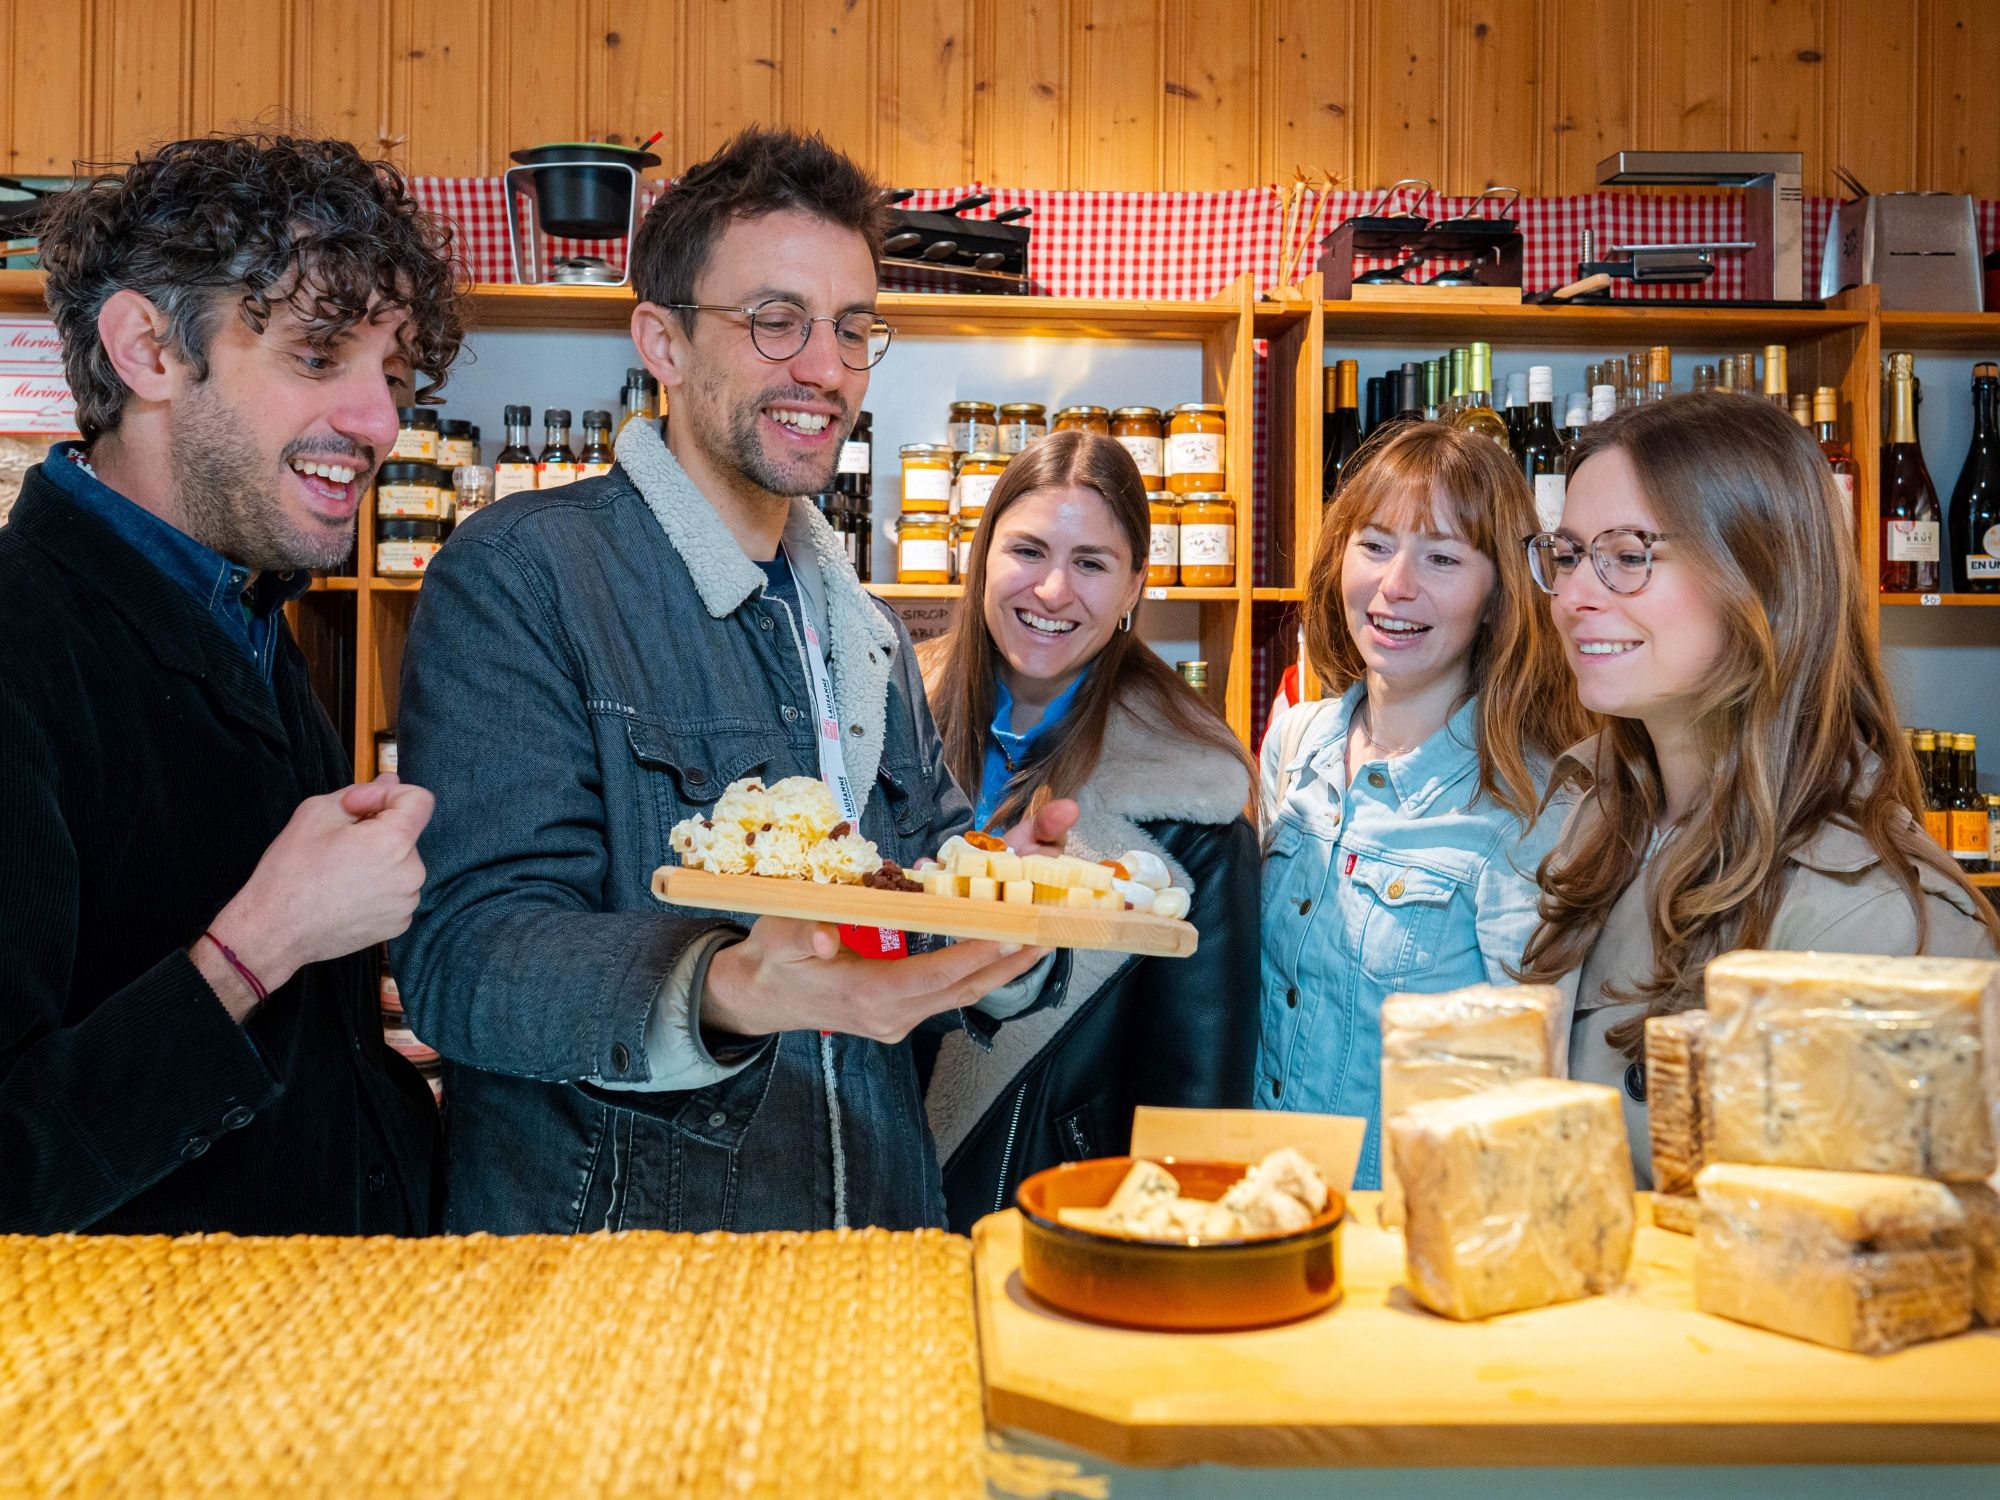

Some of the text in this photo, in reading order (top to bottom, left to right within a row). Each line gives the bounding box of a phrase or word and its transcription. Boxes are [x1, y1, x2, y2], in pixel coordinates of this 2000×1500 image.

[10, 331, 63, 353] Mering
[1971, 561, 1986, 570] EN
[901, 609, 949, 620] SIROP
[821, 677, 833, 719] LAUSANNE
[838, 775, 853, 818] LAUSANNE
